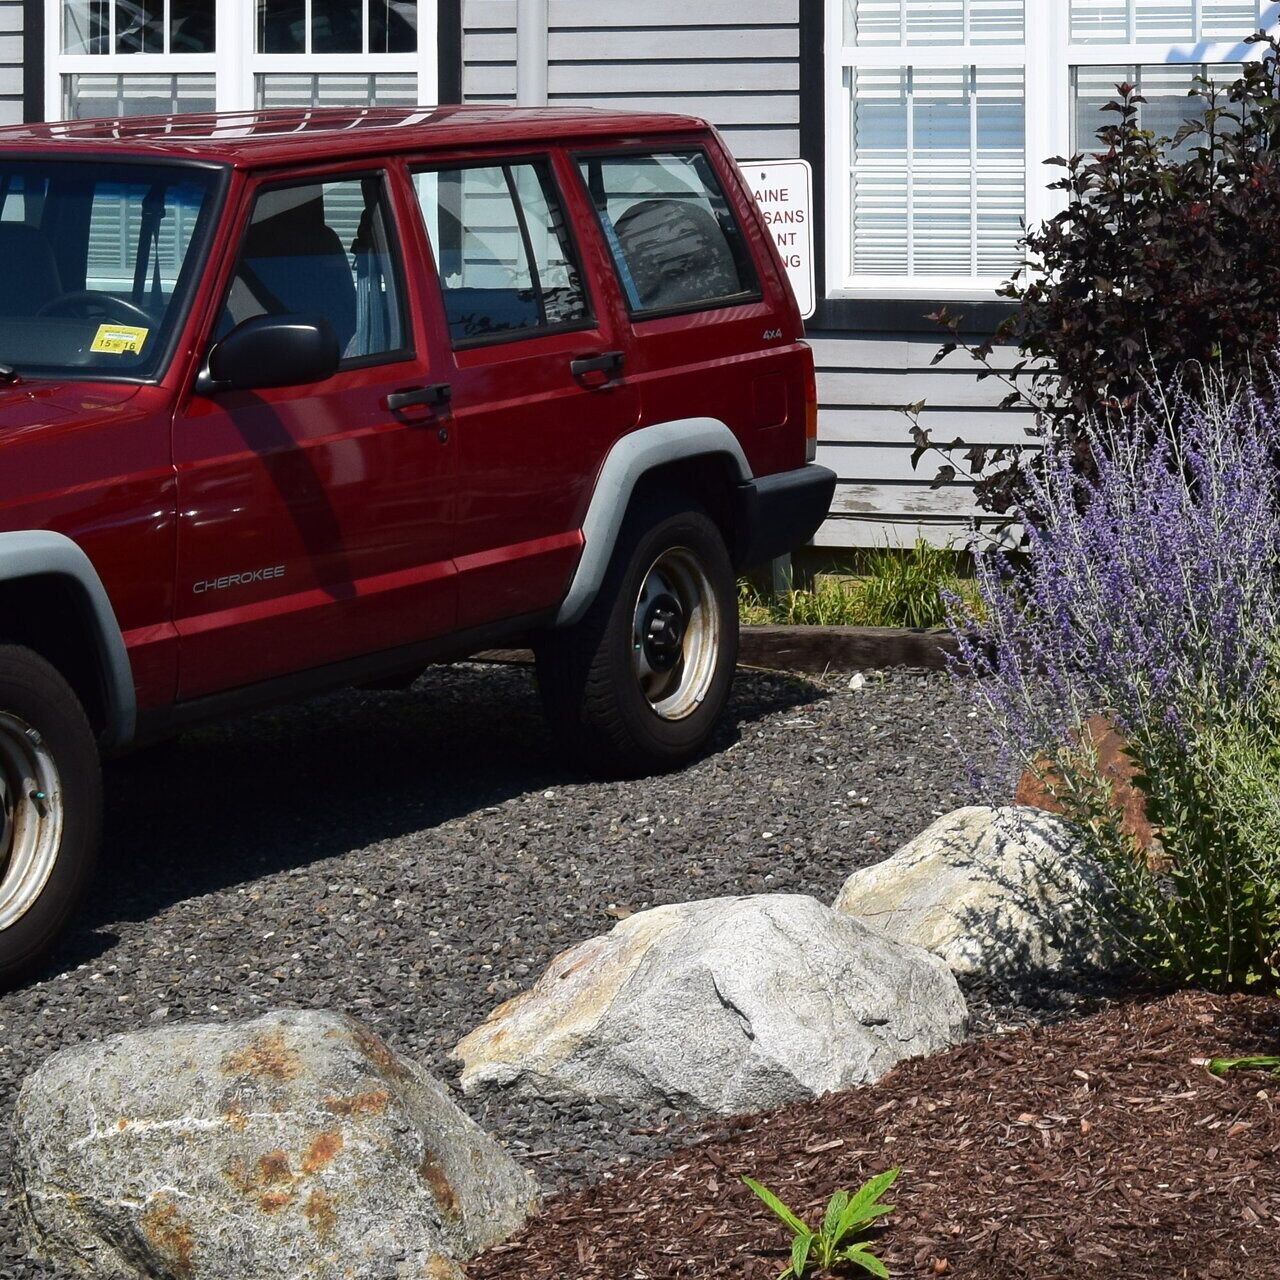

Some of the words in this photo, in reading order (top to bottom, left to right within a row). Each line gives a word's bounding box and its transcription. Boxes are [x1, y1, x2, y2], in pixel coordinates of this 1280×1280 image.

[754, 188, 789, 203] AINE
[762, 209, 805, 225] SANS
[100, 339, 111, 348] 15
[124, 342, 136, 350] 16
[193, 565, 285, 594] CHEROKEE
